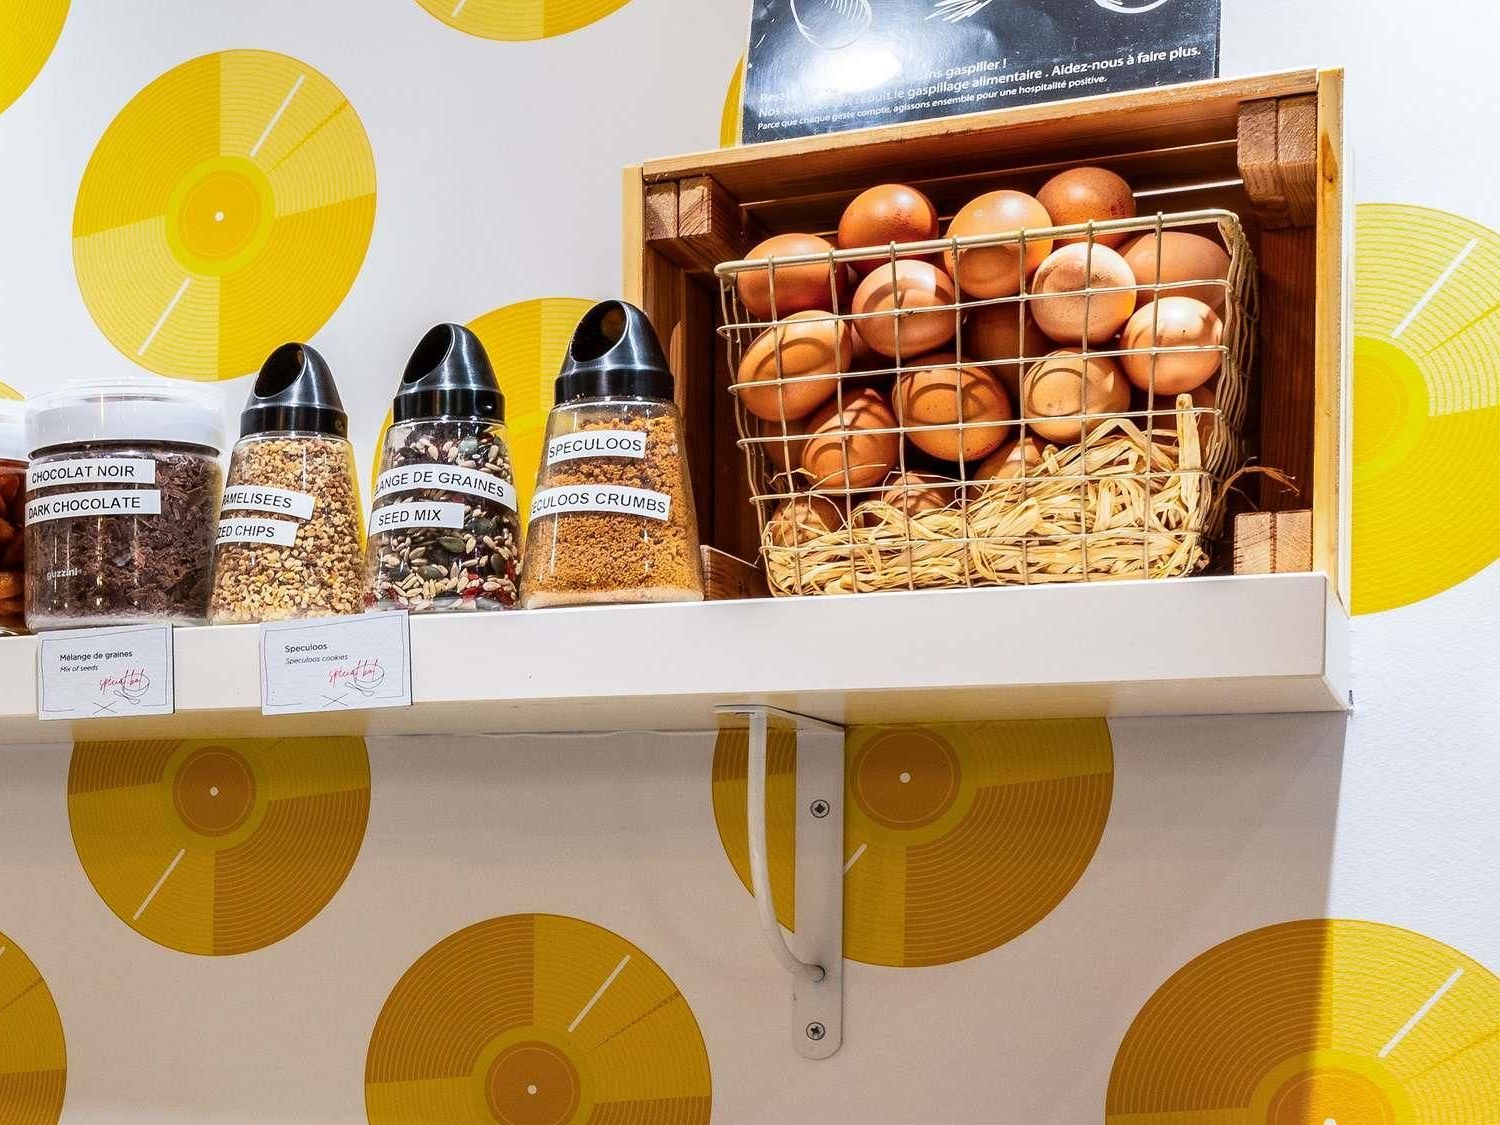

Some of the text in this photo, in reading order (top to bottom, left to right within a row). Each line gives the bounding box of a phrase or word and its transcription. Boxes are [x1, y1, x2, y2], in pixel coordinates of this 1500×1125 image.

[908, 81, 970, 99] gaspillage
[972, 70, 1043, 88] alimentaire
[1052, 56, 1123, 77] Aidez-nous
[1126, 54, 1135, 65] à
[1138, 51, 1166, 63] faire
[1170, 47, 1201, 61] plus.
[946, 61, 1000, 80] gaspiller
[757, 121, 780, 130] Parce
[781, 119, 799, 128] que
[799, 114, 831, 125] chaque
[857, 105, 892, 117] compte,
[893, 101, 930, 113] agissons
[932, 94, 975, 107] ensemble
[976, 91, 998, 102] pour
[1000, 88, 1017, 97] une
[1019, 79, 1067, 94] hospitalité
[1068, 75, 1108, 89] positive.
[549, 437, 642, 458] SPECULOOS
[31, 465, 135, 484] CHOCOLAT NOIR
[413, 471, 433, 483] DE
[438, 472, 504, 498] GRAINES
[28, 496, 141, 519] DARK CHOCOLATE
[595, 492, 666, 514] CRUMBS
[378, 509, 442, 526] SEED MIX
[235, 525, 276, 538] CHIPS
[60, 650, 133, 662] Mélange de graines
[285, 643, 328, 654] Speculoos
[285, 654, 349, 665] Speculoos cookies
